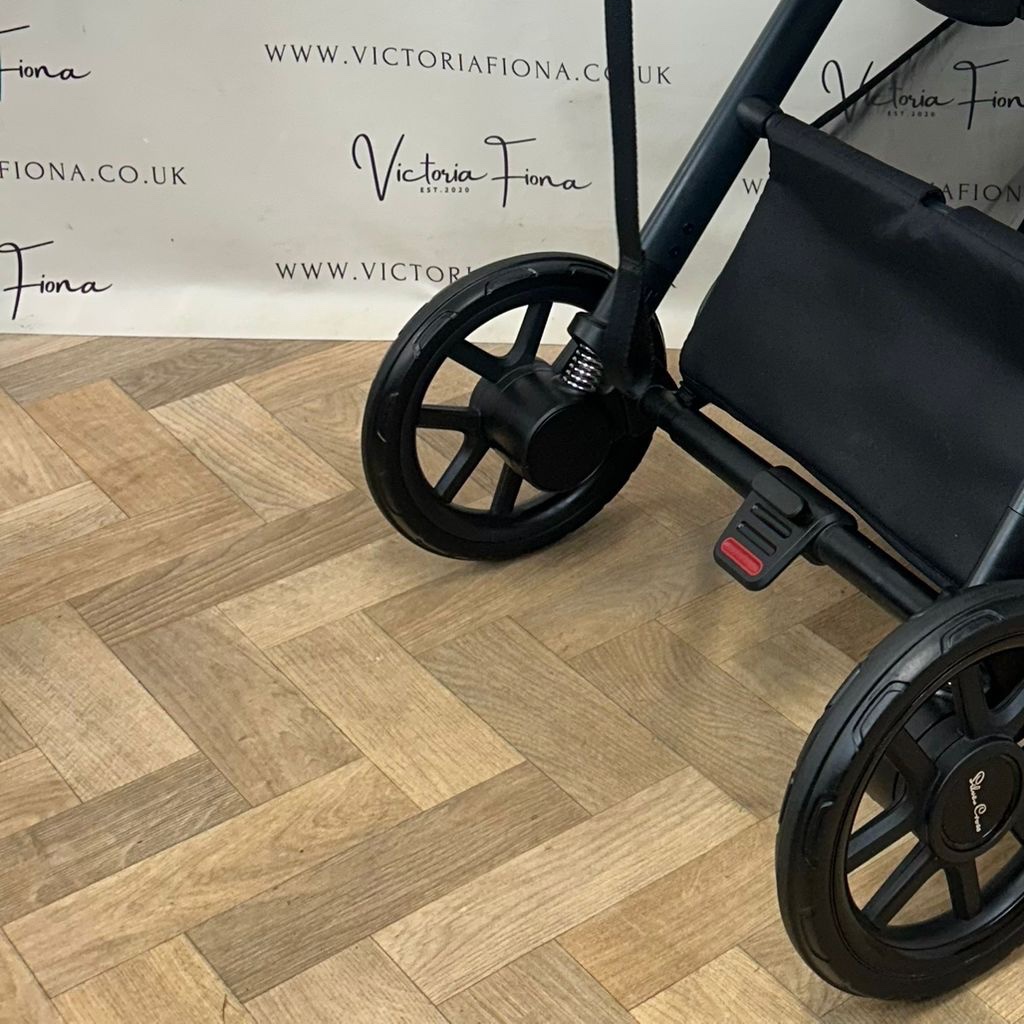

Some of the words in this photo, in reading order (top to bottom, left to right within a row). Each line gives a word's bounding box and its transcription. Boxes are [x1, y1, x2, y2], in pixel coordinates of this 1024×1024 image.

[263, 42, 674, 87] WWW.VICTORIAFIONA.C.UK
[351, 133, 489, 202] Victoria
[482, 135, 593, 209] Fiona
[419, 186, 470, 194] EST.2020
[0, 240, 113, 321] Fiona
